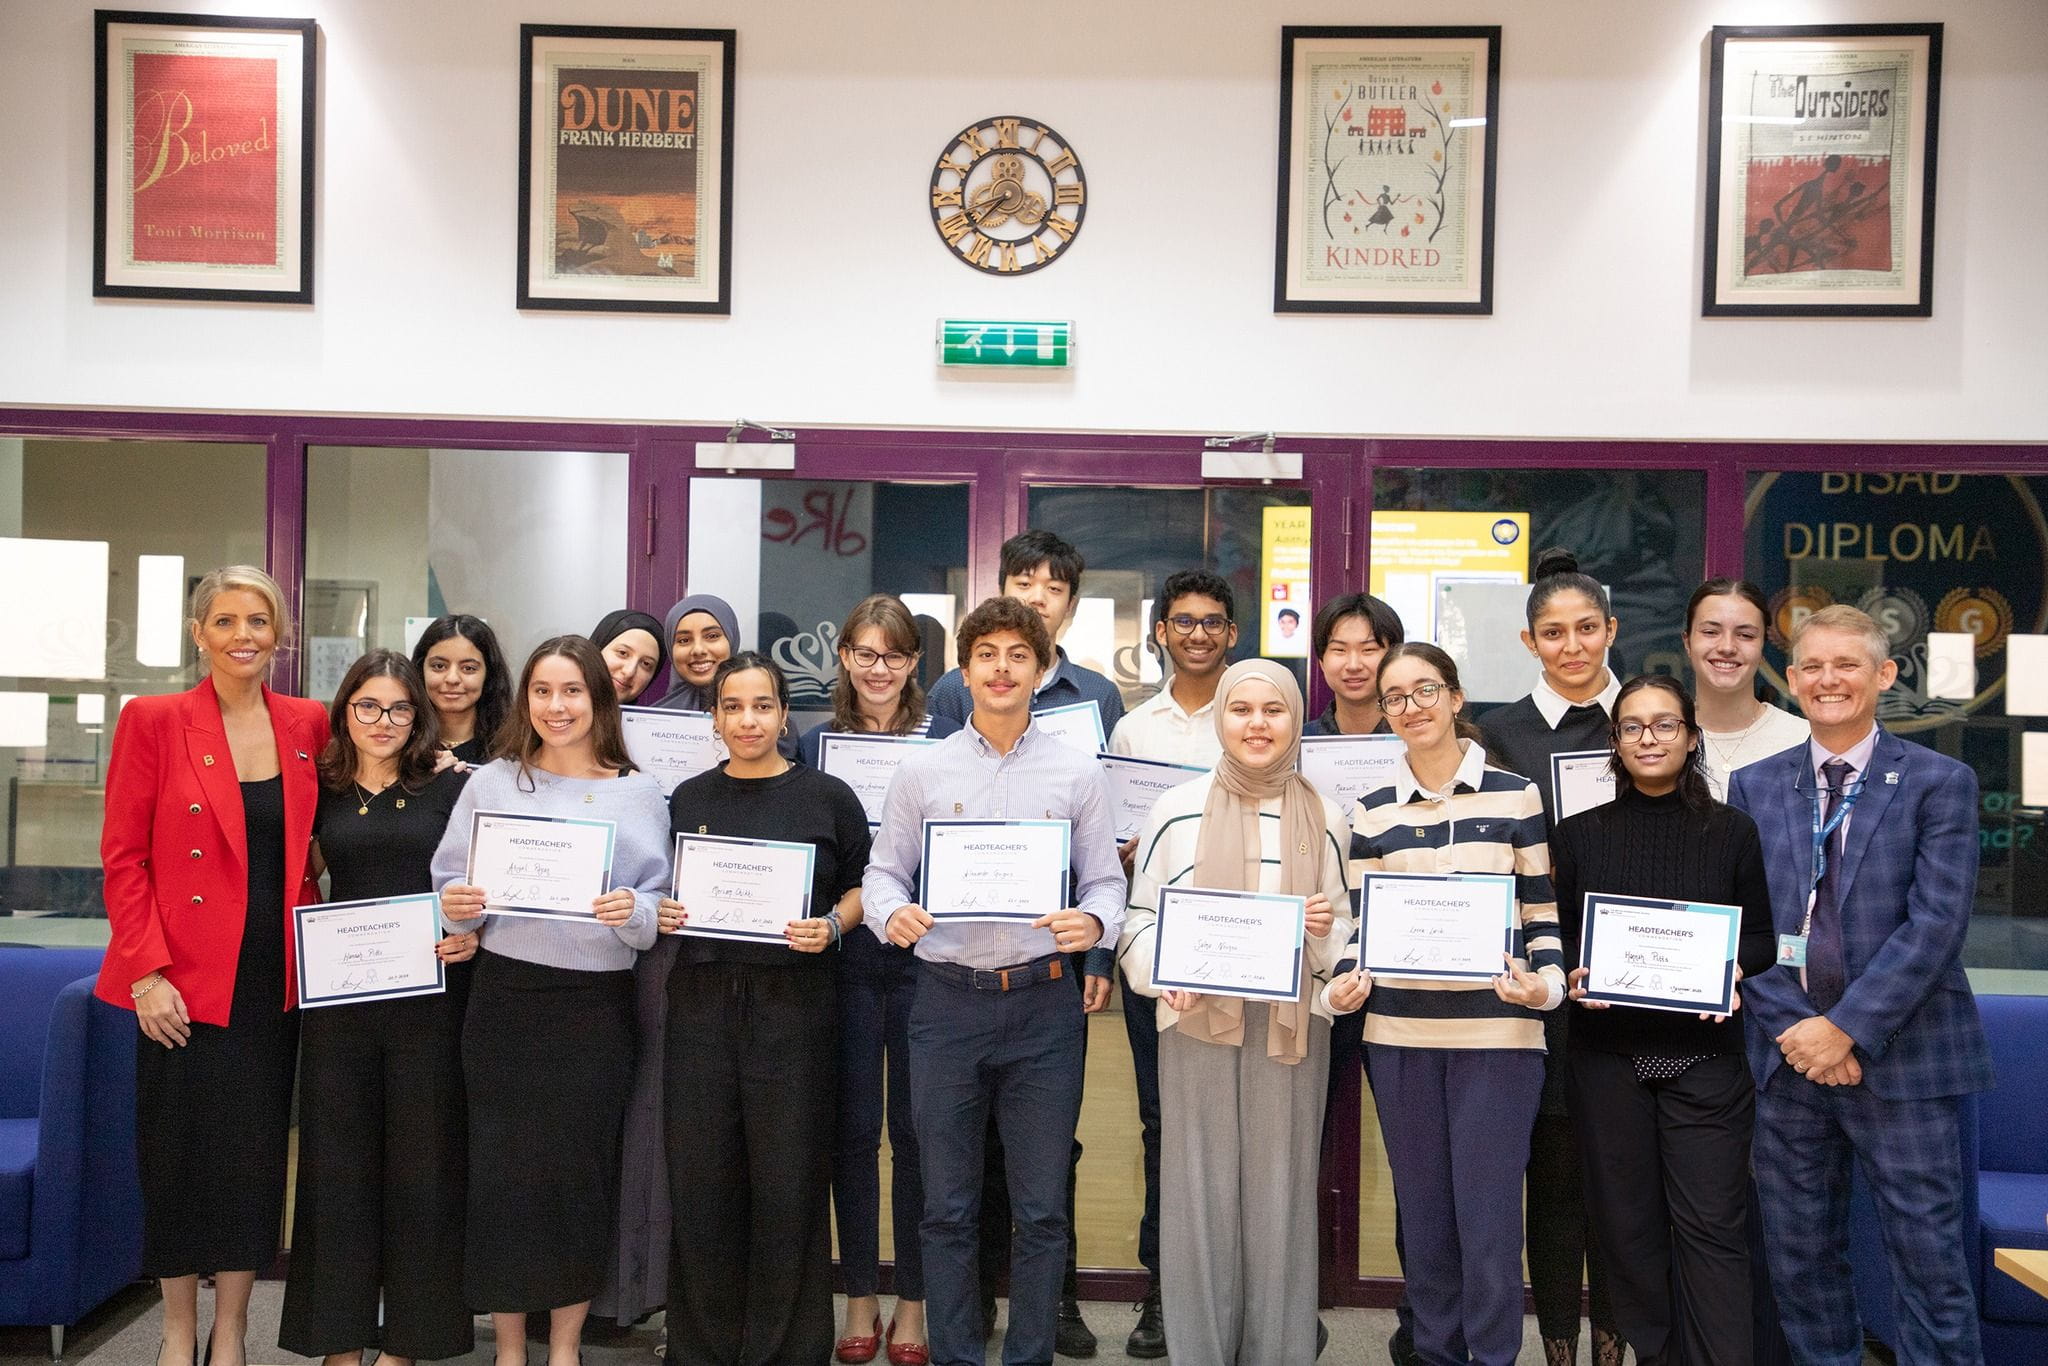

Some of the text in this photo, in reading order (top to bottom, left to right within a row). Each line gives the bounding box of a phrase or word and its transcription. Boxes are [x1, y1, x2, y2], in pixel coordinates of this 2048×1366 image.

[1358, 84, 1417, 101] BUTLER
[560, 83, 695, 133] DUNE
[134, 89, 270, 193] Beloved
[560, 129, 694, 149] FRANK HERBERT
[1816, 133, 1862, 141] HINTON
[144, 224, 266, 242] Toni Morrison
[1326, 245, 1441, 270] KINDRED
[1273, 520, 1306, 529] YEAR
[1783, 523, 1997, 562] DIPLOMA
[1960, 608, 1984, 633] G
[651, 731, 710, 742] HEADTEACHER'S
[1334, 758, 1395, 767] HEADTEACHER'S
[509, 837, 573, 850] HEADTEACHER'S
[712, 861, 773, 873] HEADTEACHER'S
[1404, 898, 1471, 908] HEADTEACHER'S
[1198, 914, 1263, 927] HEADTEACHER'S
[337, 922, 401, 935] HEADTEACHER'S
[1628, 925, 1694, 938] HEADTEACHER'S
